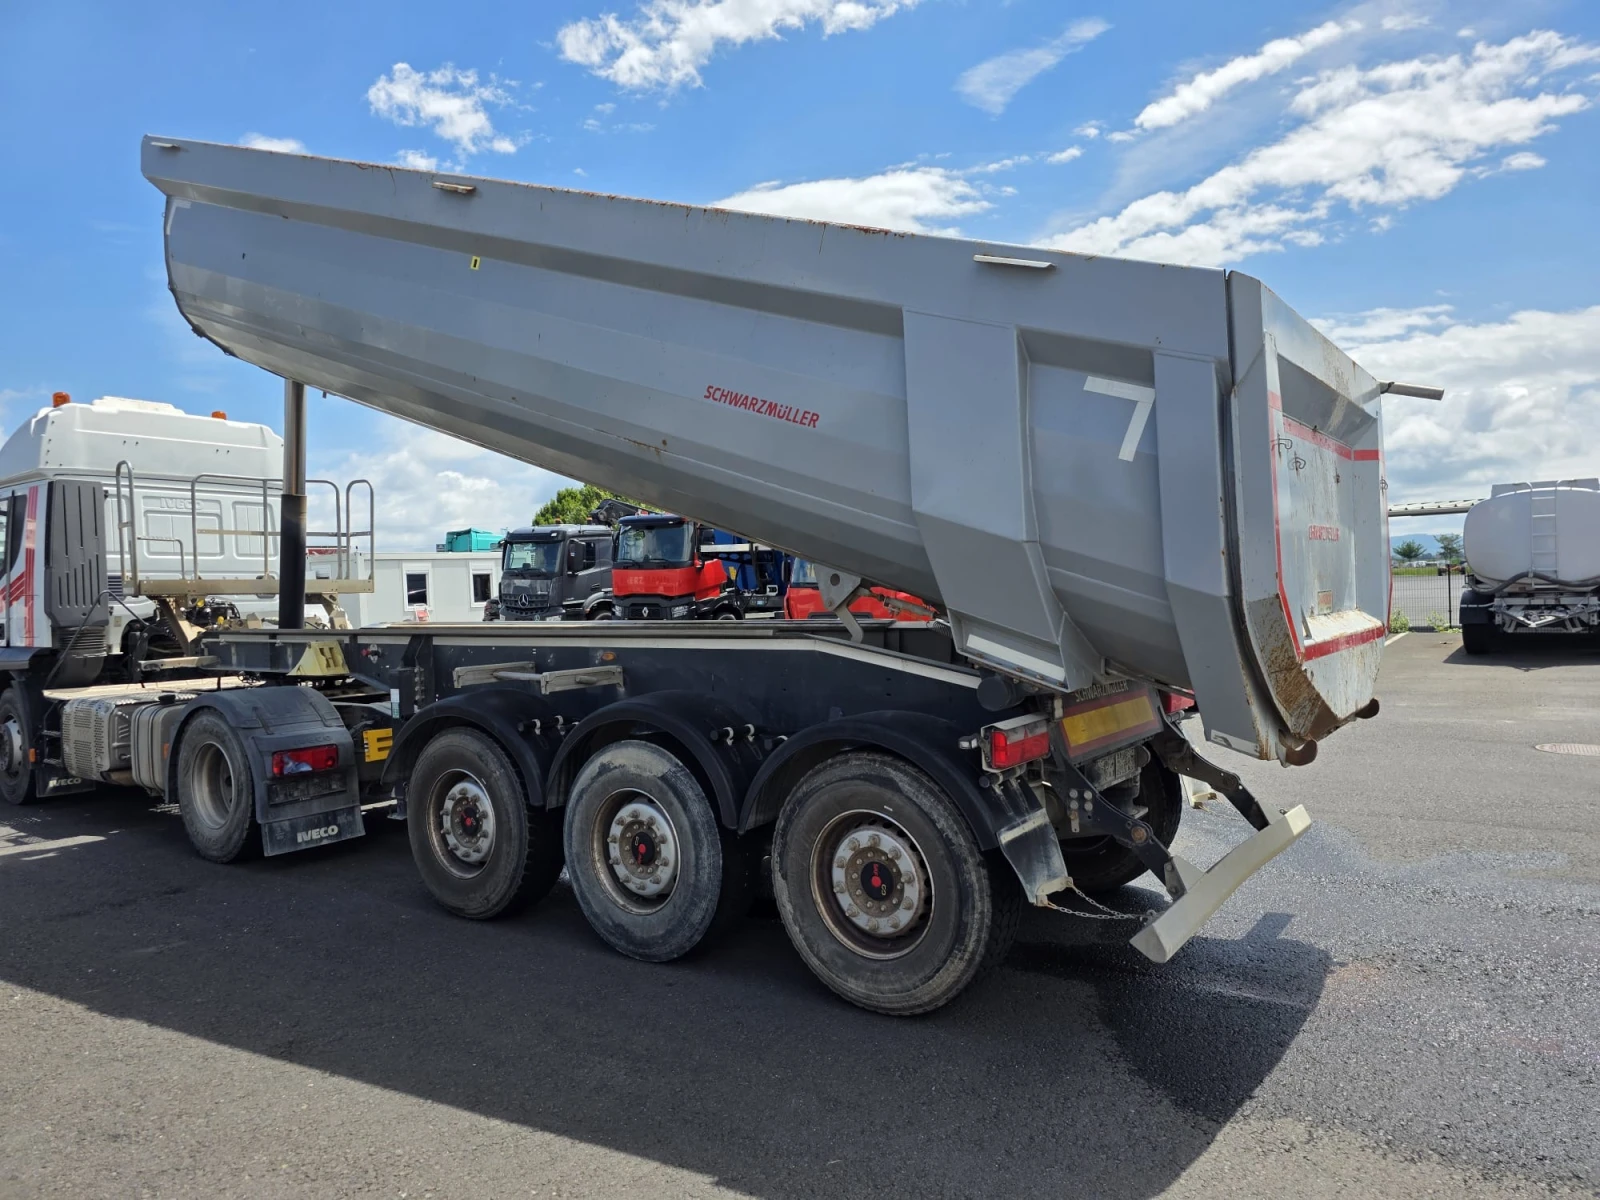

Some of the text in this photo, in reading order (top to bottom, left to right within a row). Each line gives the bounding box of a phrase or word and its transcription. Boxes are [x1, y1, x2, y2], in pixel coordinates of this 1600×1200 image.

[703, 384, 820, 429] SCHWARZMÜLLER
[1083, 375, 1156, 462] 7
[160, 497, 204, 510] IVECO
[296, 824, 339, 843] IVECO
